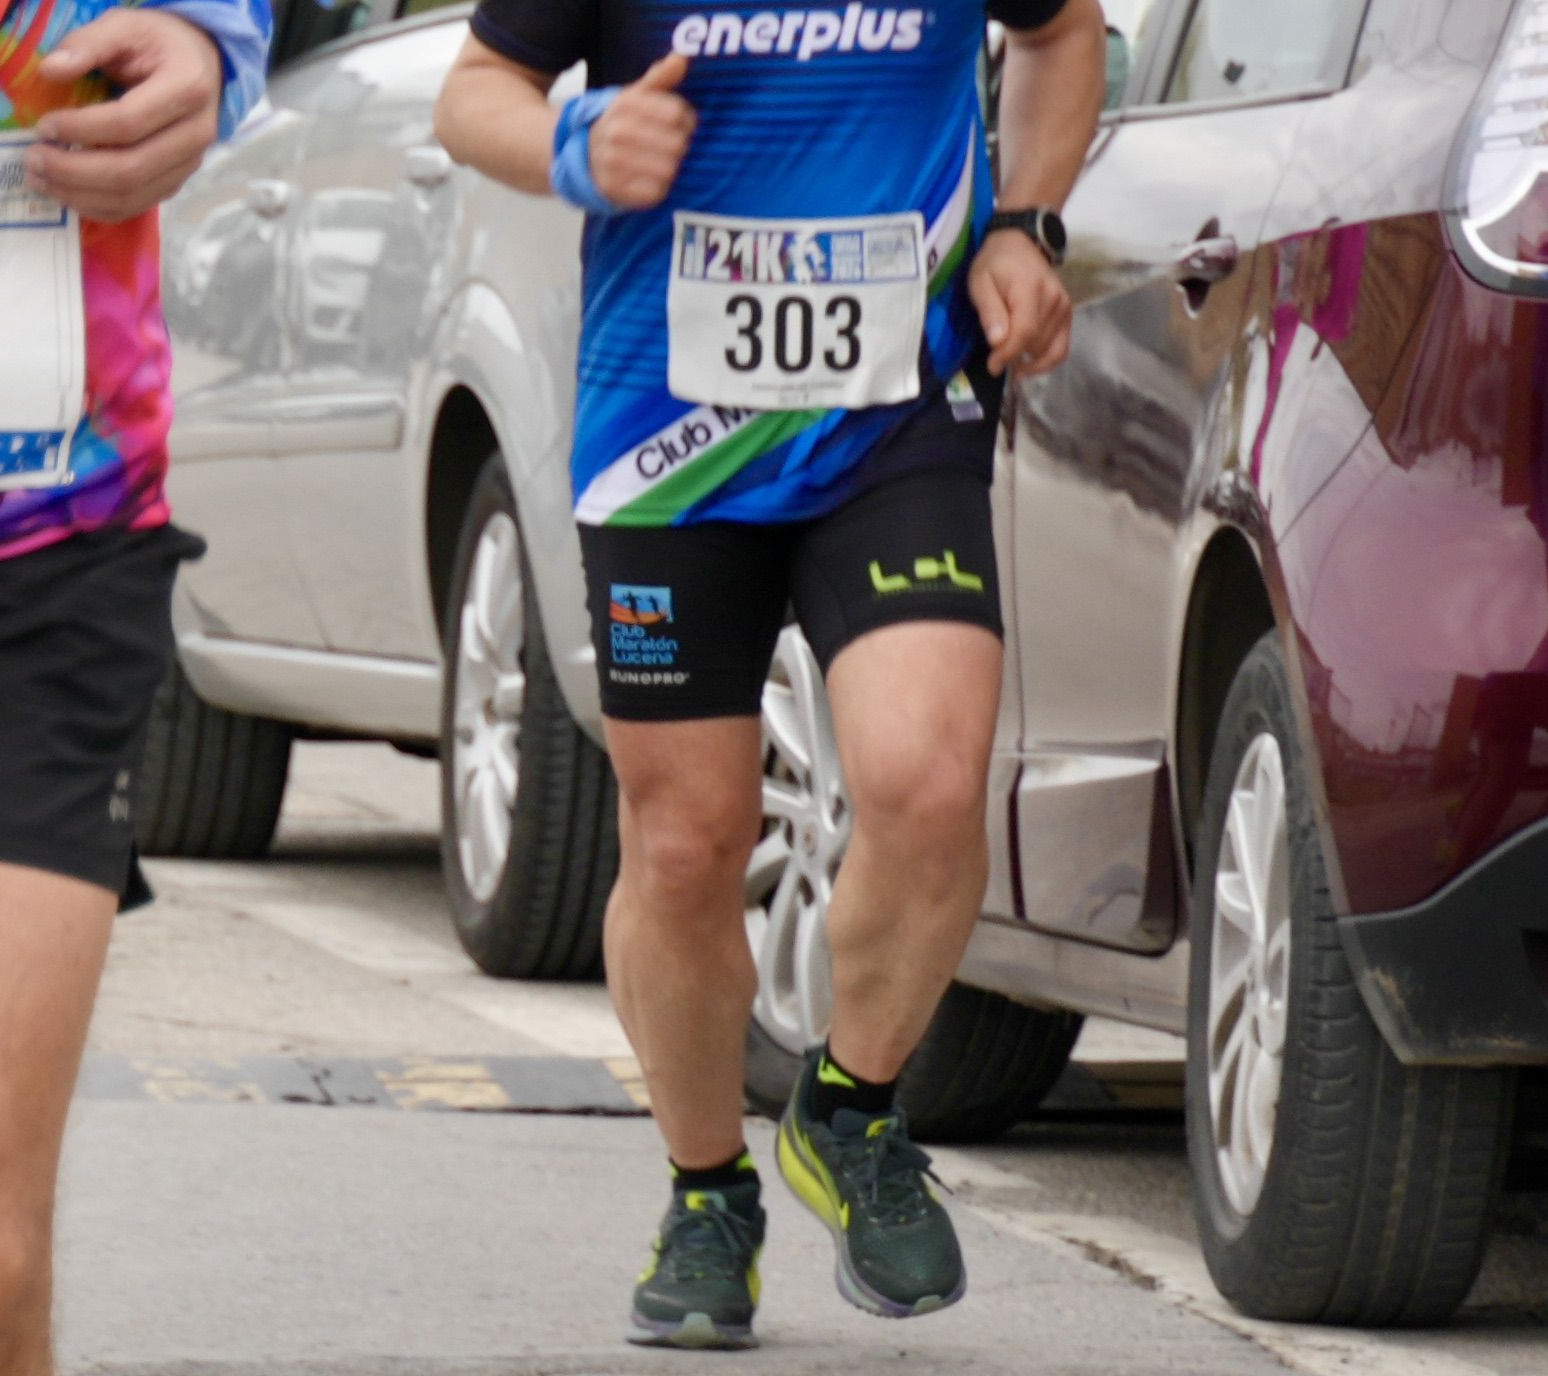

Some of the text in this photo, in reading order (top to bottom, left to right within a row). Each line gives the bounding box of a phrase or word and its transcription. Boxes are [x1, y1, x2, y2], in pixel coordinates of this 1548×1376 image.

[672, 1, 923, 62] enerplus
[707, 228, 784, 282] 21K
[724, 294, 862, 373] 303
[636, 421, 712, 479] Club
[611, 623, 645, 637] Club
[612, 634, 680, 652] Maratón
[613, 651, 674, 664] Lucena
